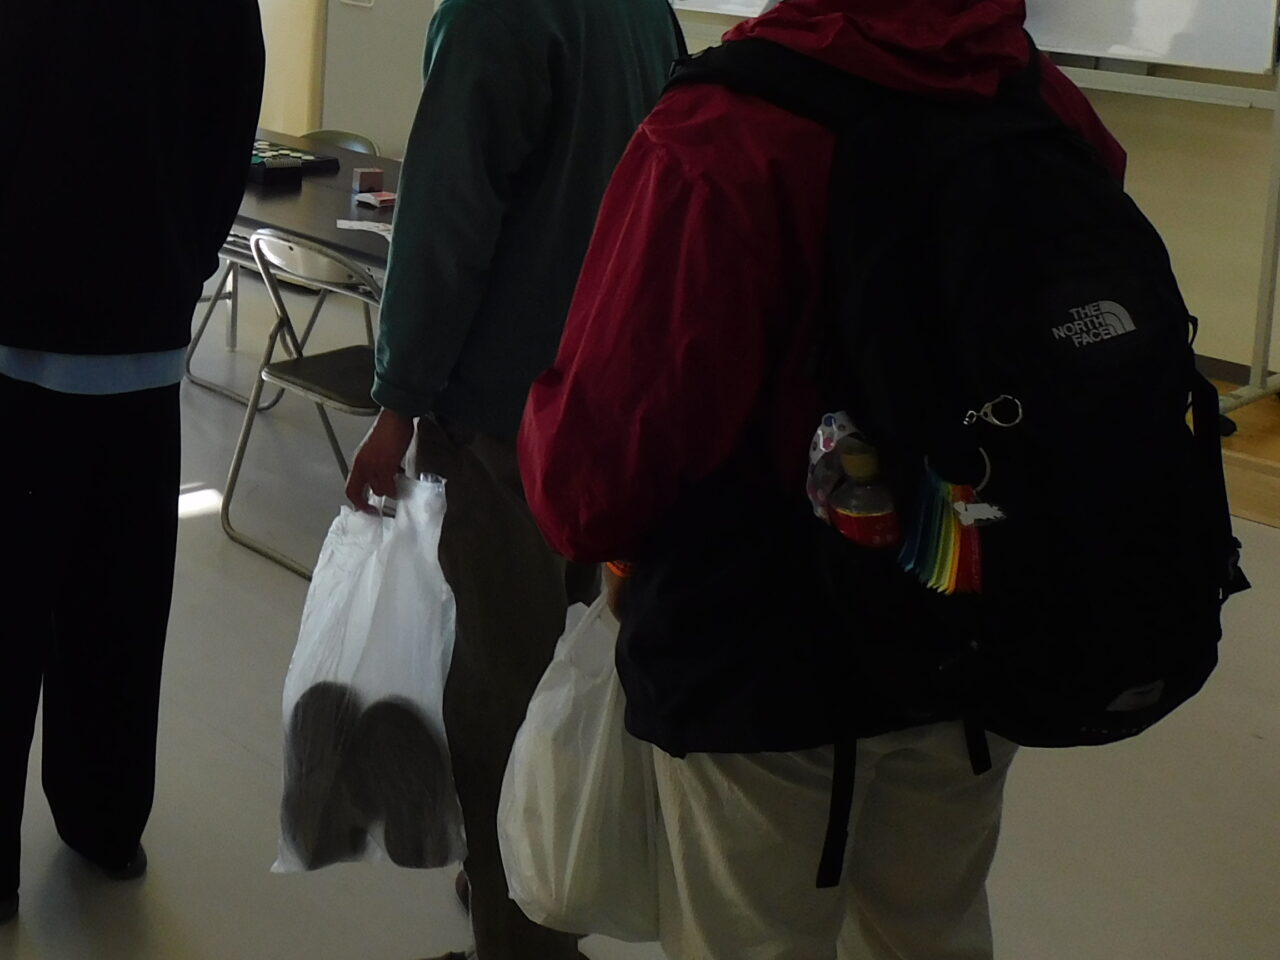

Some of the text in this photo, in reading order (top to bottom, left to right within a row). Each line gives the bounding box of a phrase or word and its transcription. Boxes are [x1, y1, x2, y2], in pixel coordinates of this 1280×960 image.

[1068, 302, 1101, 320] THE
[1051, 315, 1106, 340] NORTH
[1071, 325, 1113, 348] FACE
